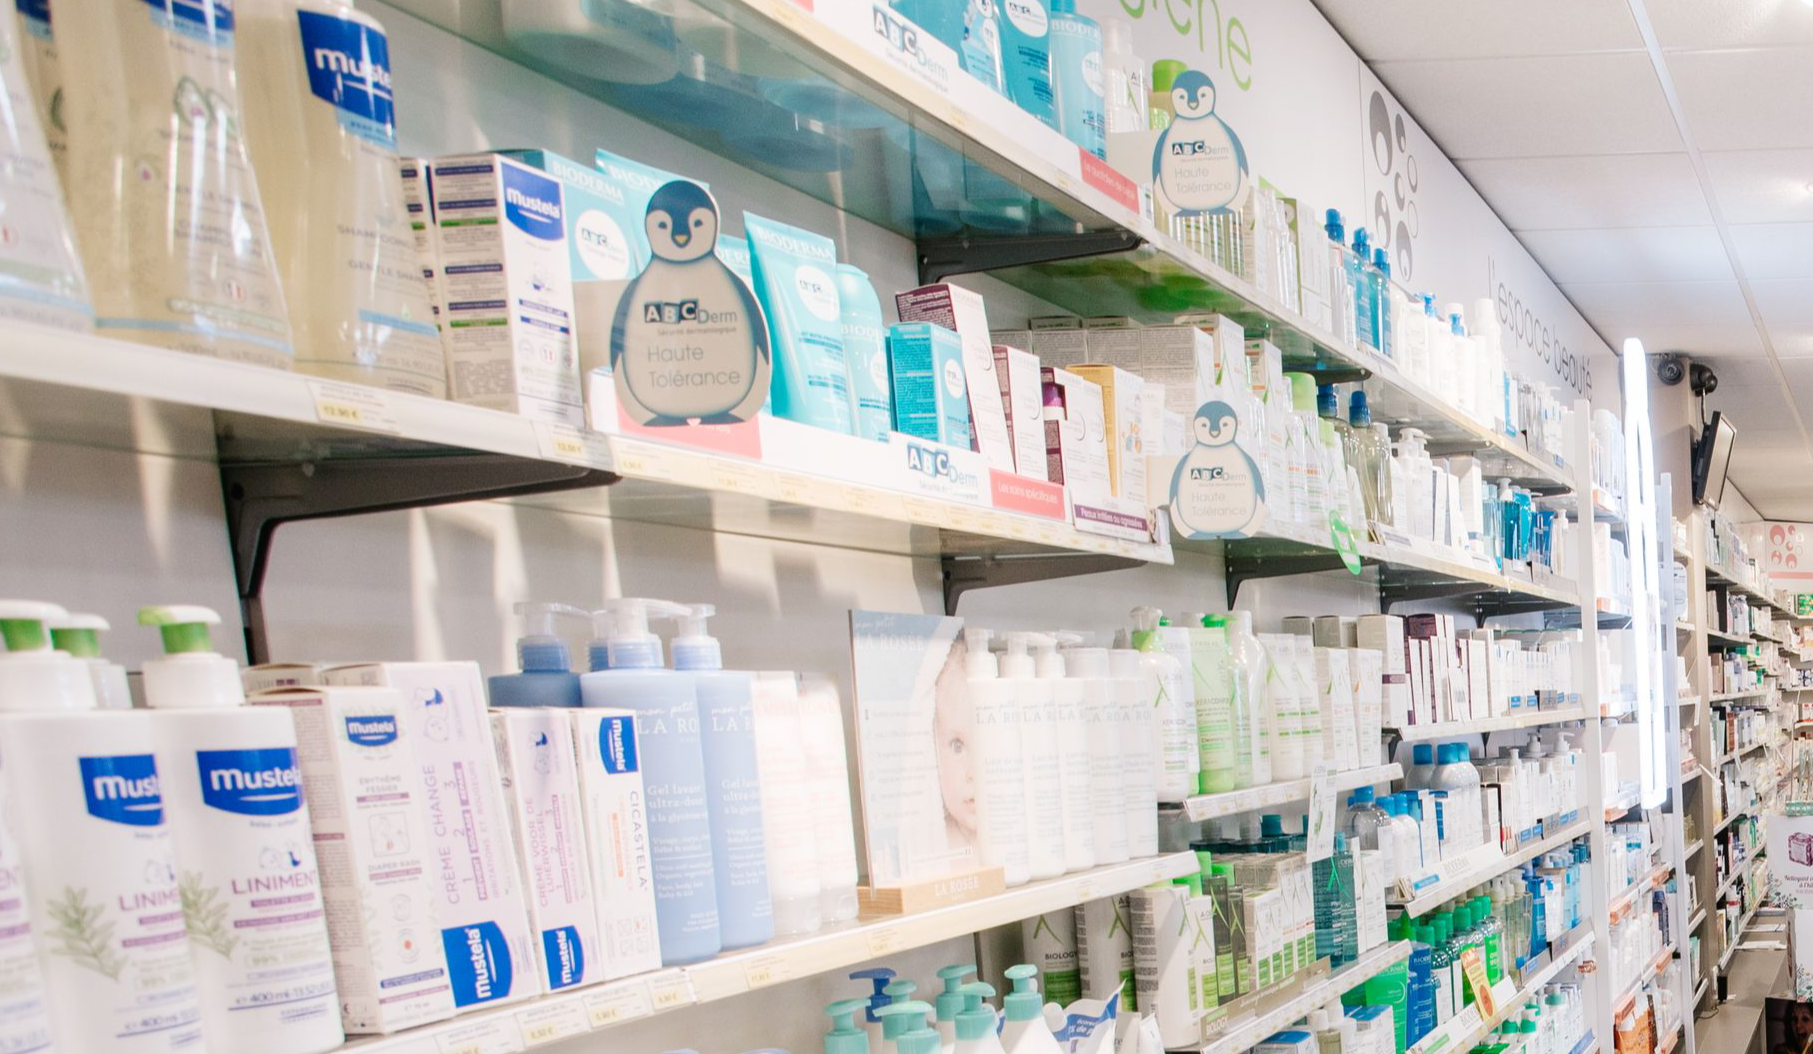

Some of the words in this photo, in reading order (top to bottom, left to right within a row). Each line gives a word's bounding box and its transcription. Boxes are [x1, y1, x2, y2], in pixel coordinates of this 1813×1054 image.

[1174, 166, 1209, 179] Haute
[1175, 180, 1232, 194] Tolérance
[1488, 255, 1551, 365] l'espace
[1554, 327, 1593, 402] beauté
[647, 344, 704, 363] Haute
[649, 367, 741, 389] Tolérance
[1192, 492, 1225, 503] Haute
[1192, 505, 1247, 518] Tolérance
[428, 764, 447, 837] CHANGE
[445, 846, 461, 905] CRÈME
[934, 884, 947, 897] LA
